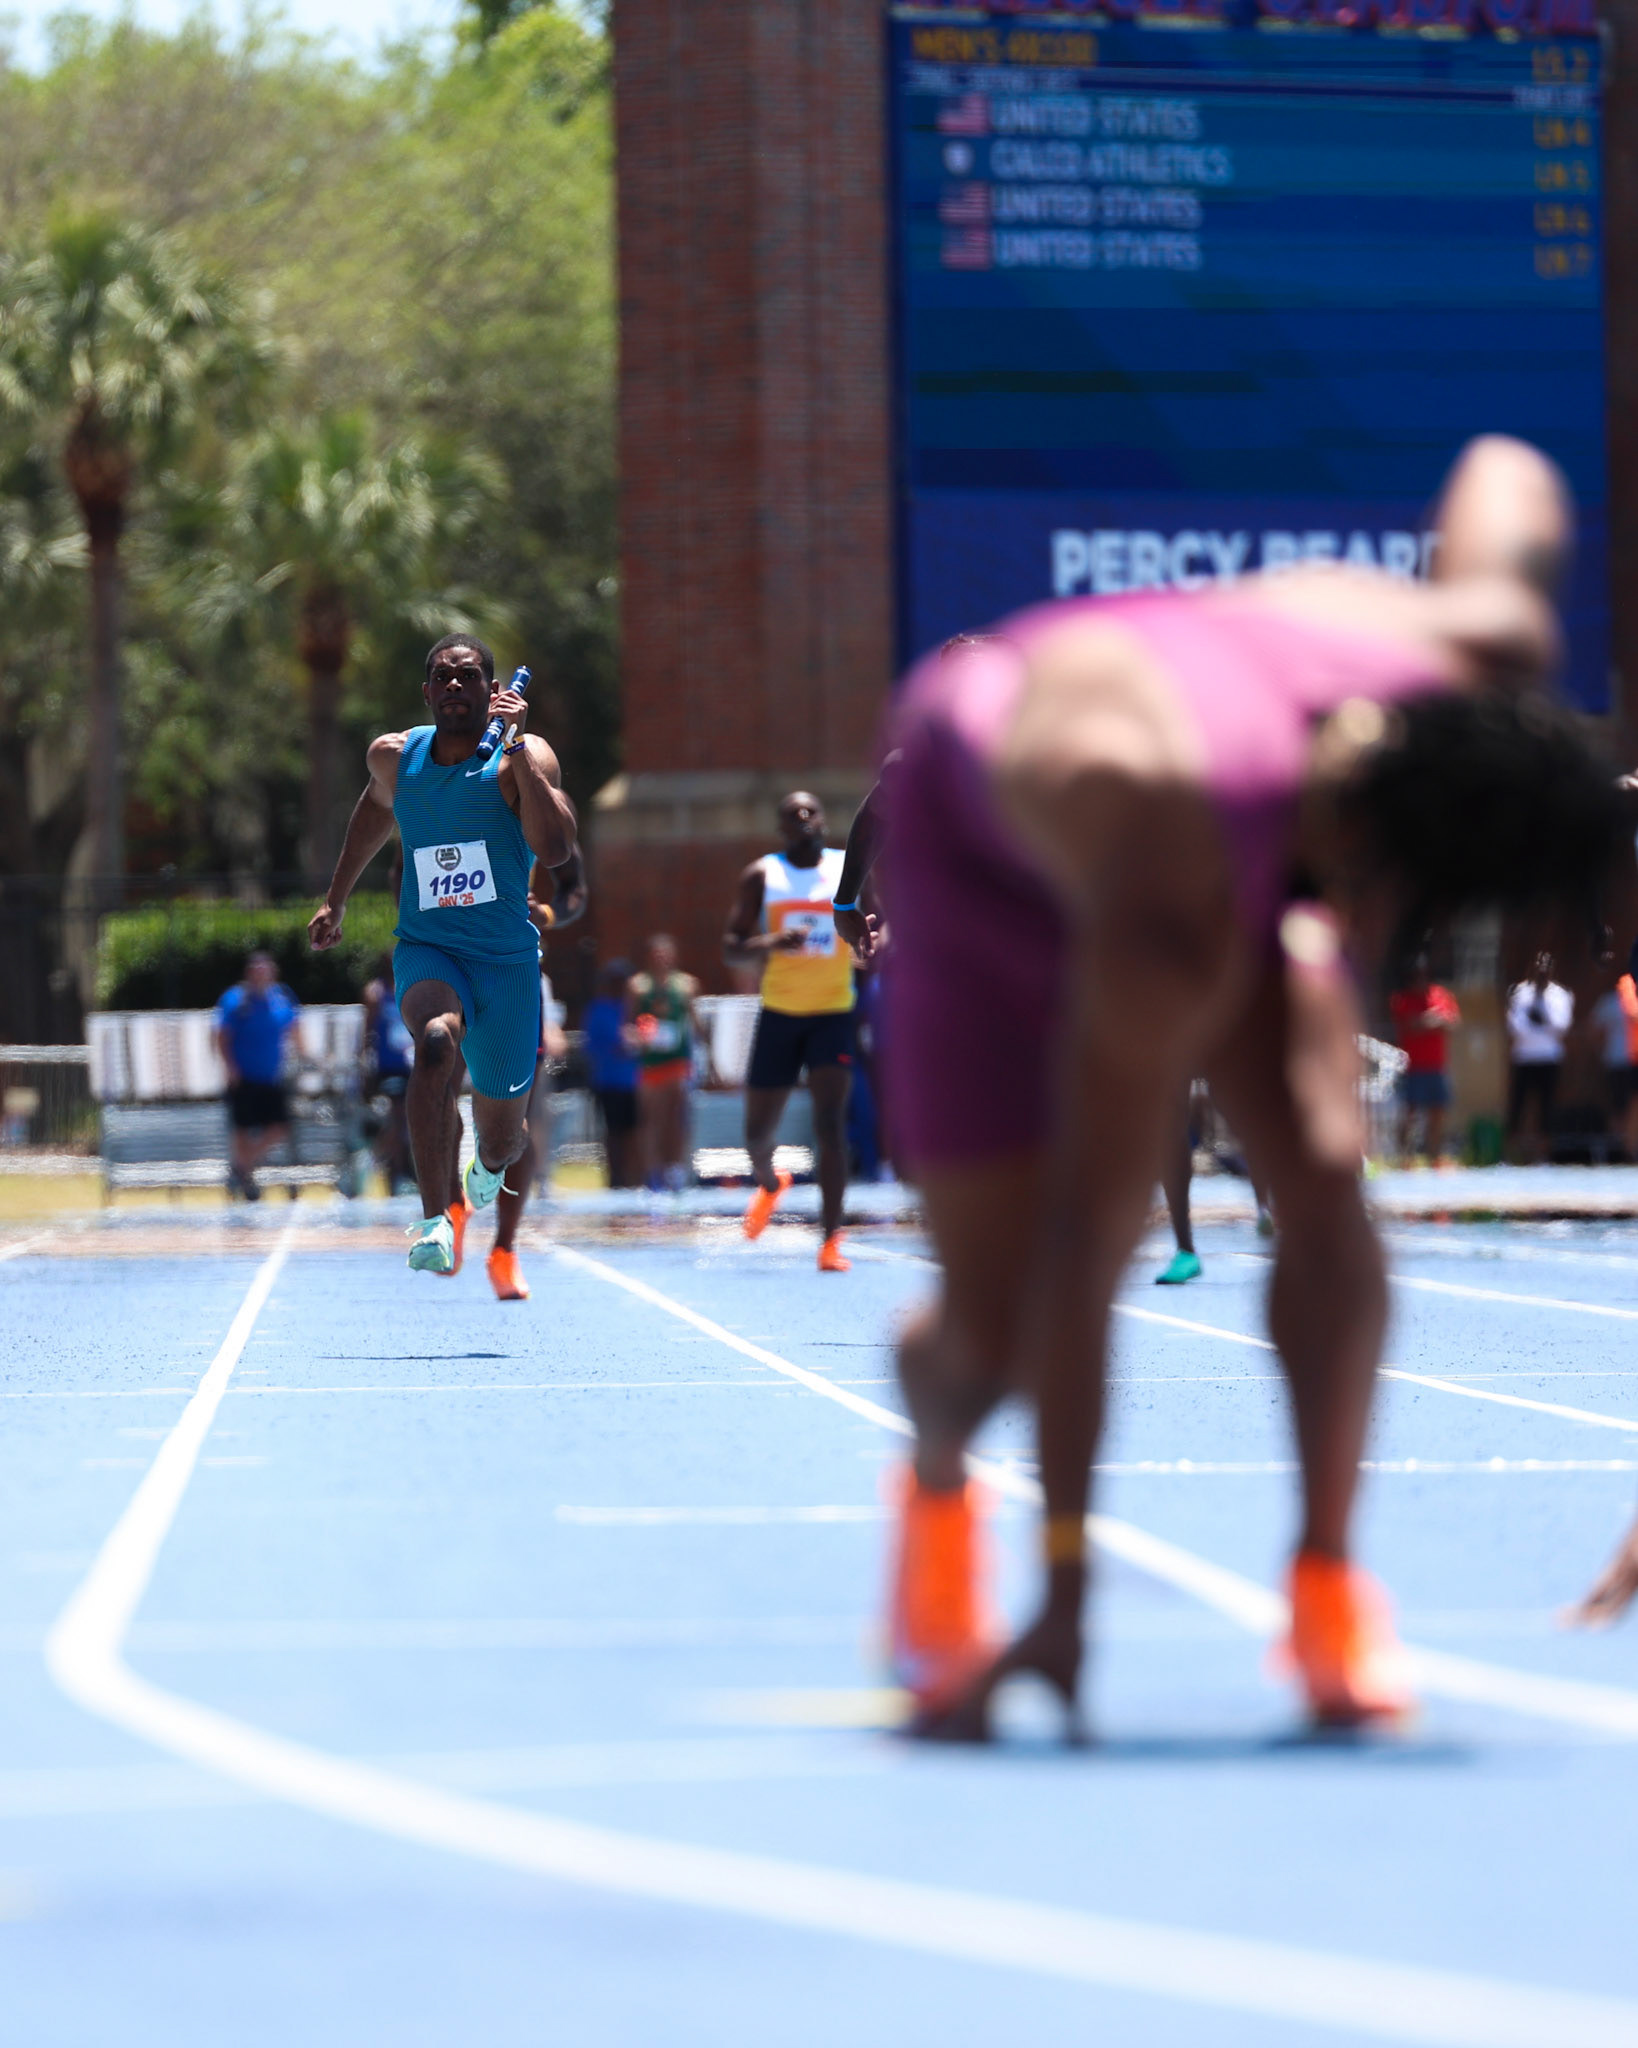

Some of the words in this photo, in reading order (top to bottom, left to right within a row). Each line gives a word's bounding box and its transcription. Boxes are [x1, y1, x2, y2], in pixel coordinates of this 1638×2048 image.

[991, 97, 1091, 134] UNITED
[1099, 99, 1200, 138] STATES
[992, 184, 1094, 226] UNITED
[1101, 187, 1201, 228] STATES
[992, 230, 1093, 269] UNITED
[1101, 232, 1201, 270] STATES
[1051, 529, 1250, 597] PERCY
[429, 869, 486, 897] 1190
[438, 895, 457, 907] GNV
[459, 892, 475, 905] '25
